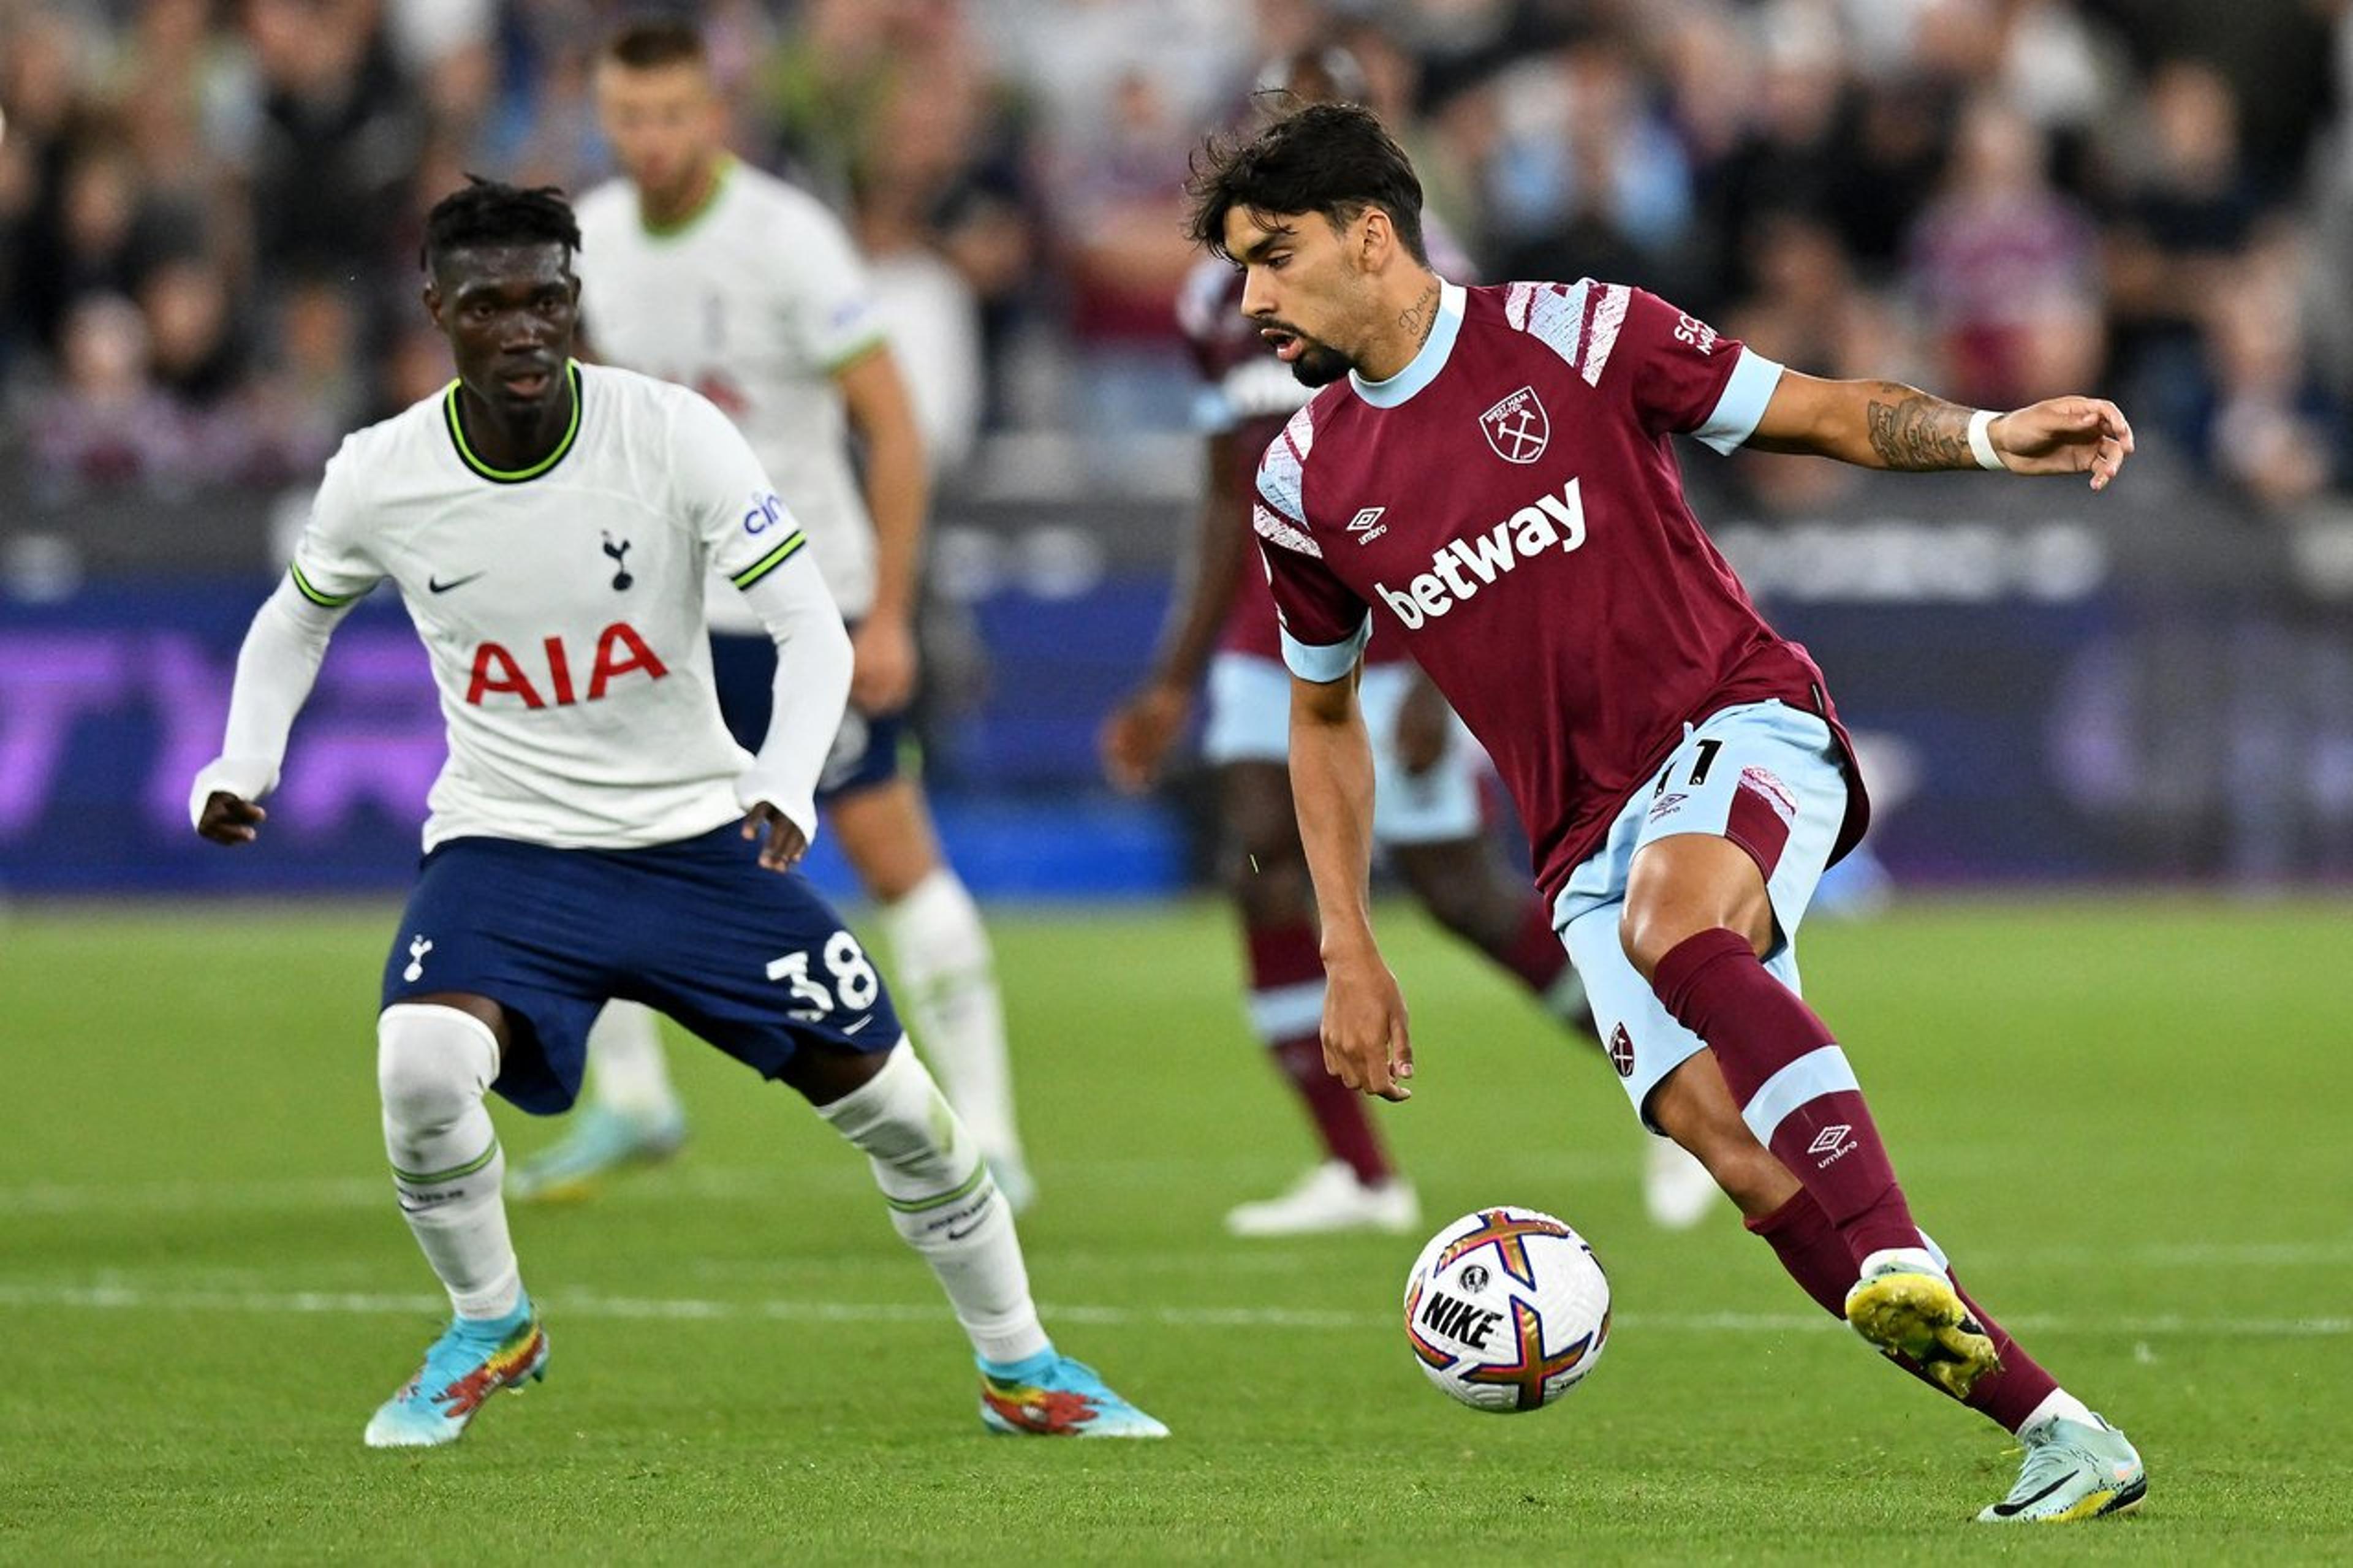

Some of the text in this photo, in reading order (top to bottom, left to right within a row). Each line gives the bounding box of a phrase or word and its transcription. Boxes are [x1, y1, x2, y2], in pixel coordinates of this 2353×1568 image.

[1358, 524, 1387, 545] umbro
[1374, 476, 1586, 630] betway
[466, 621, 669, 710] AIA
[766, 930, 879, 1023] 38
[1817, 1141, 1858, 1168] umbro
[1421, 1291, 1506, 1350] NIKE
